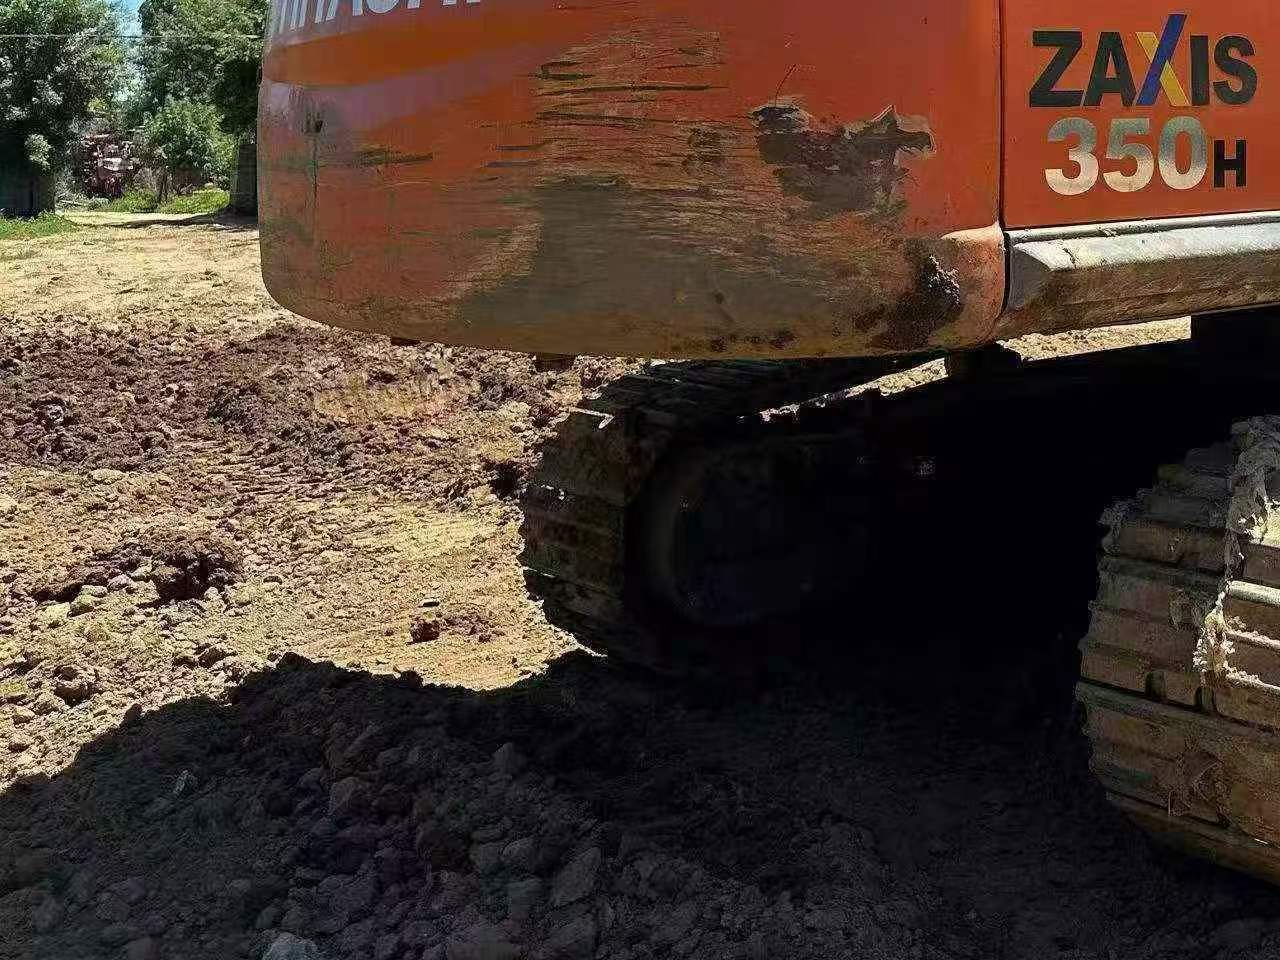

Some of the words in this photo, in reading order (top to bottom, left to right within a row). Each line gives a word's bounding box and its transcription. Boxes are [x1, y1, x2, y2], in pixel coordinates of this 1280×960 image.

[1029, 13, 1257, 108] ZAXIS
[1044, 116, 1208, 196] 350
[1213, 139, 1247, 188] H
